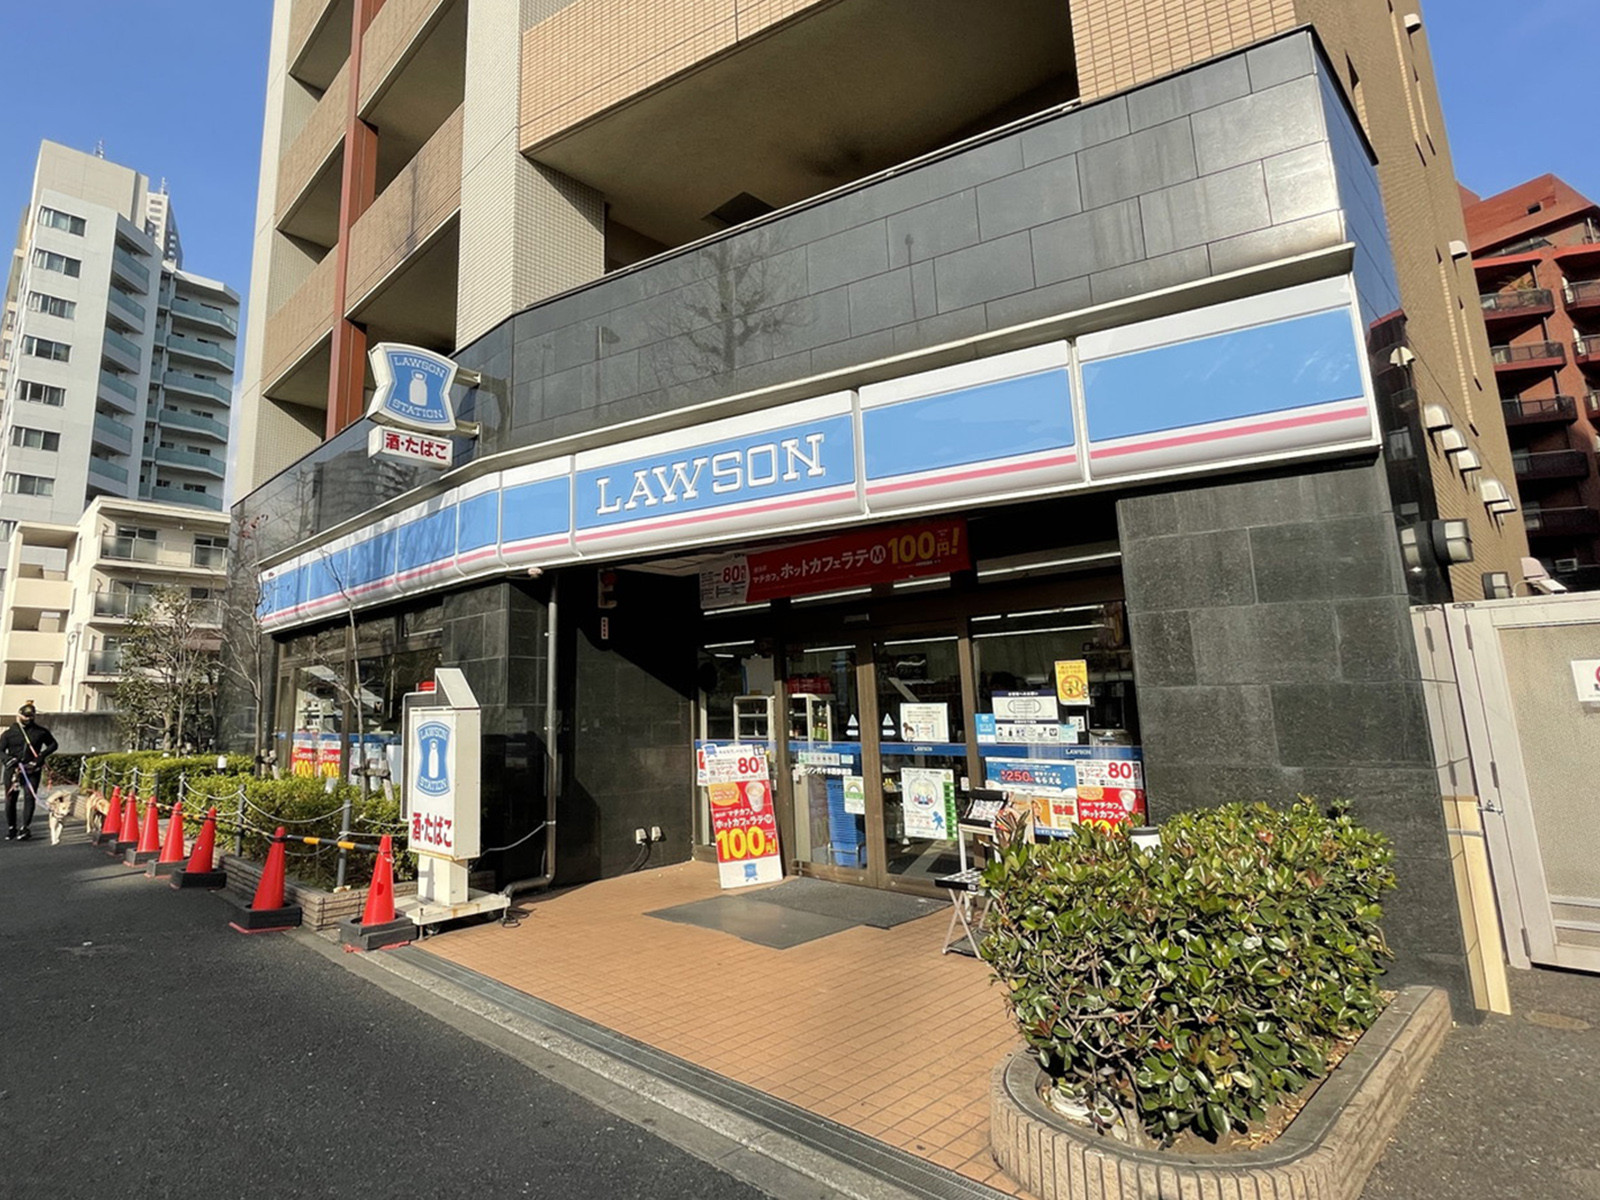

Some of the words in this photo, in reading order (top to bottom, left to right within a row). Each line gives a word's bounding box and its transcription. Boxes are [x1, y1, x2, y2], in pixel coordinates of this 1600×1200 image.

[393, 356, 445, 378] LAWSON
[391, 399, 443, 419] STATION
[596, 432, 826, 515] LAWSON
[420, 727, 448, 740] LAWSON
[1108, 762, 1132, 779] 80
